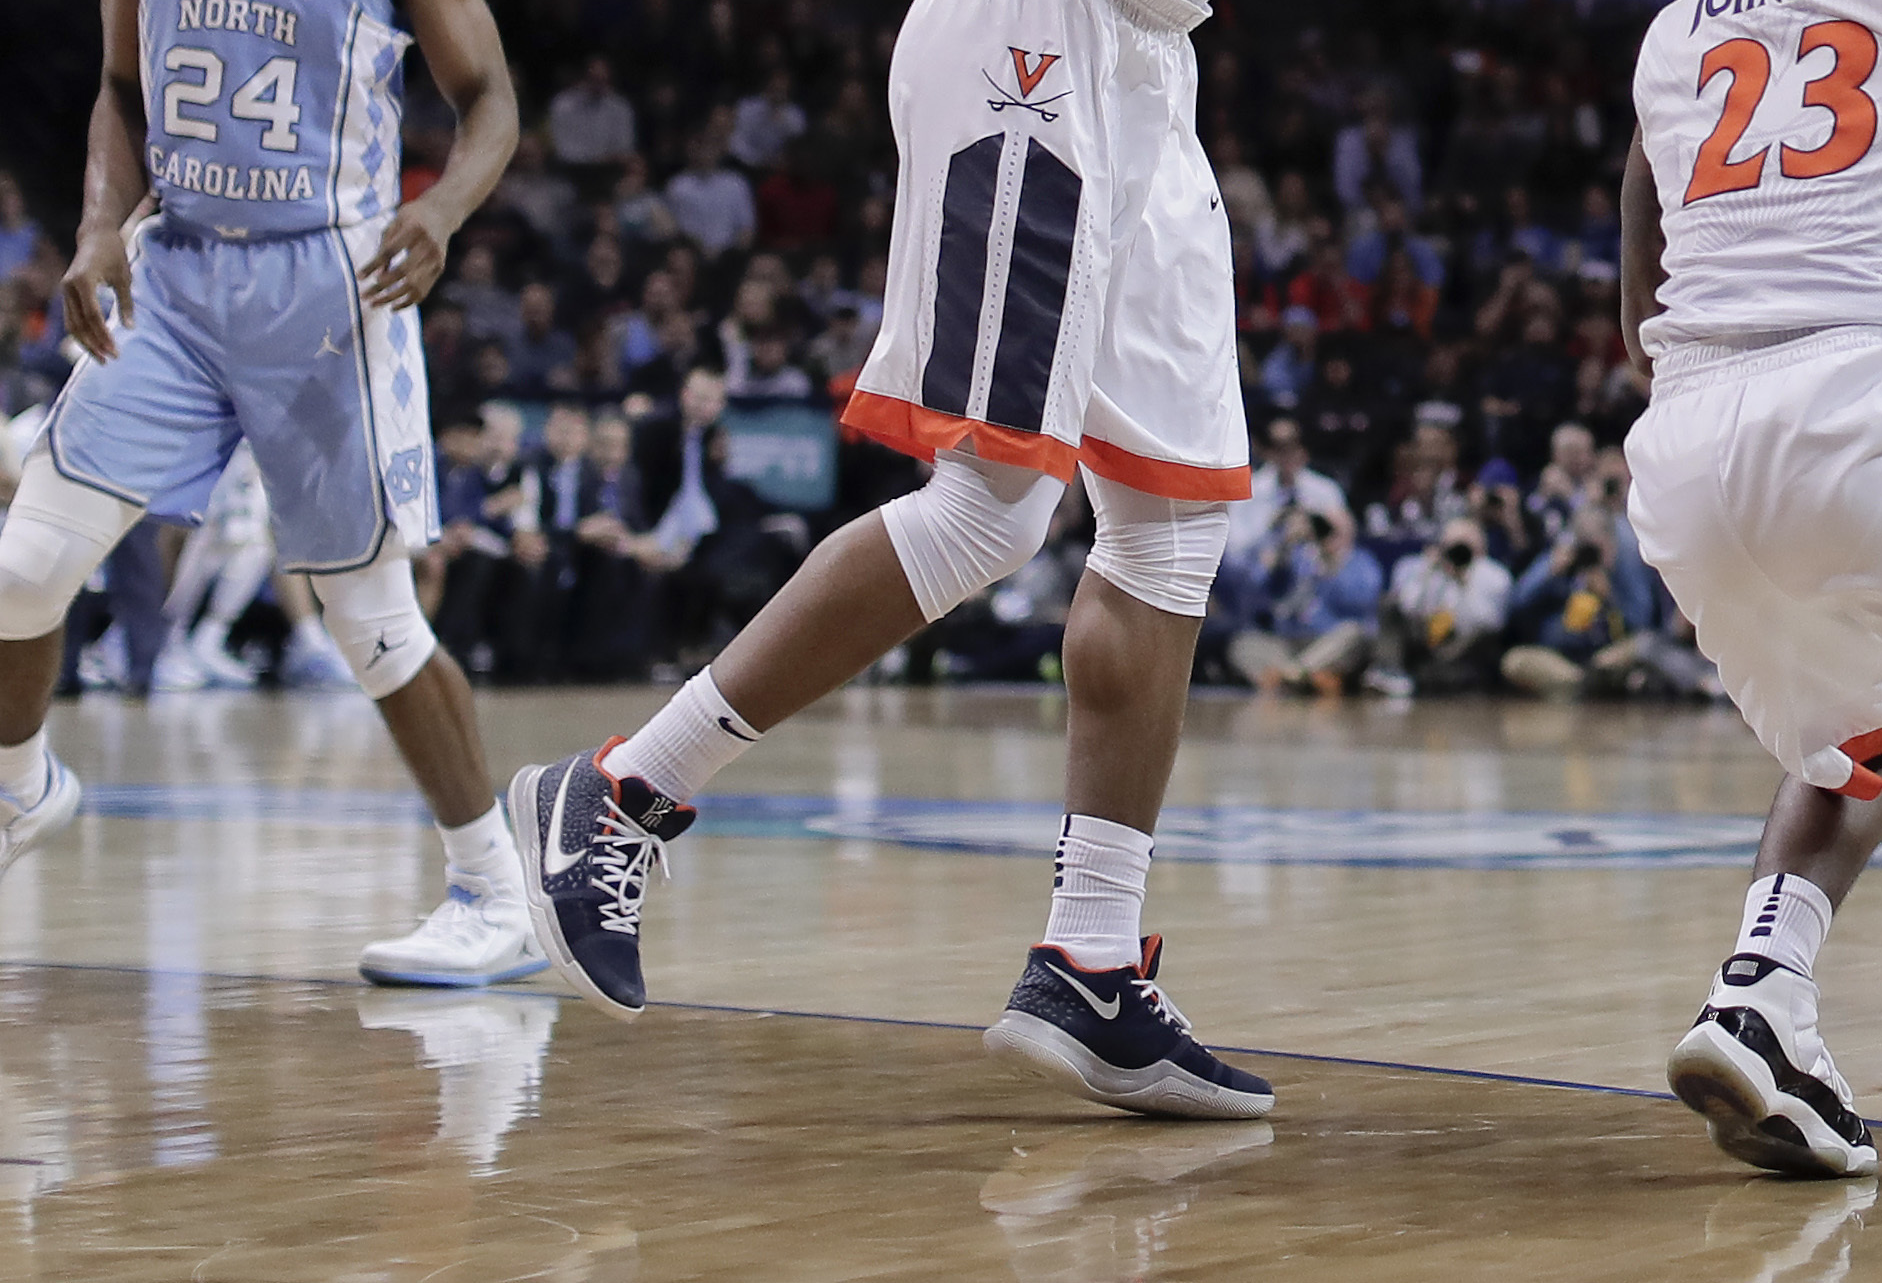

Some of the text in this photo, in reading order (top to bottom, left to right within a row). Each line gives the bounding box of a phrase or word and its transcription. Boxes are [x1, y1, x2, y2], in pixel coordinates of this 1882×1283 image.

[163, 46, 301, 152] 24
[1682, 19, 1879, 207] 23
[149, 144, 314, 201] CAROLINA
